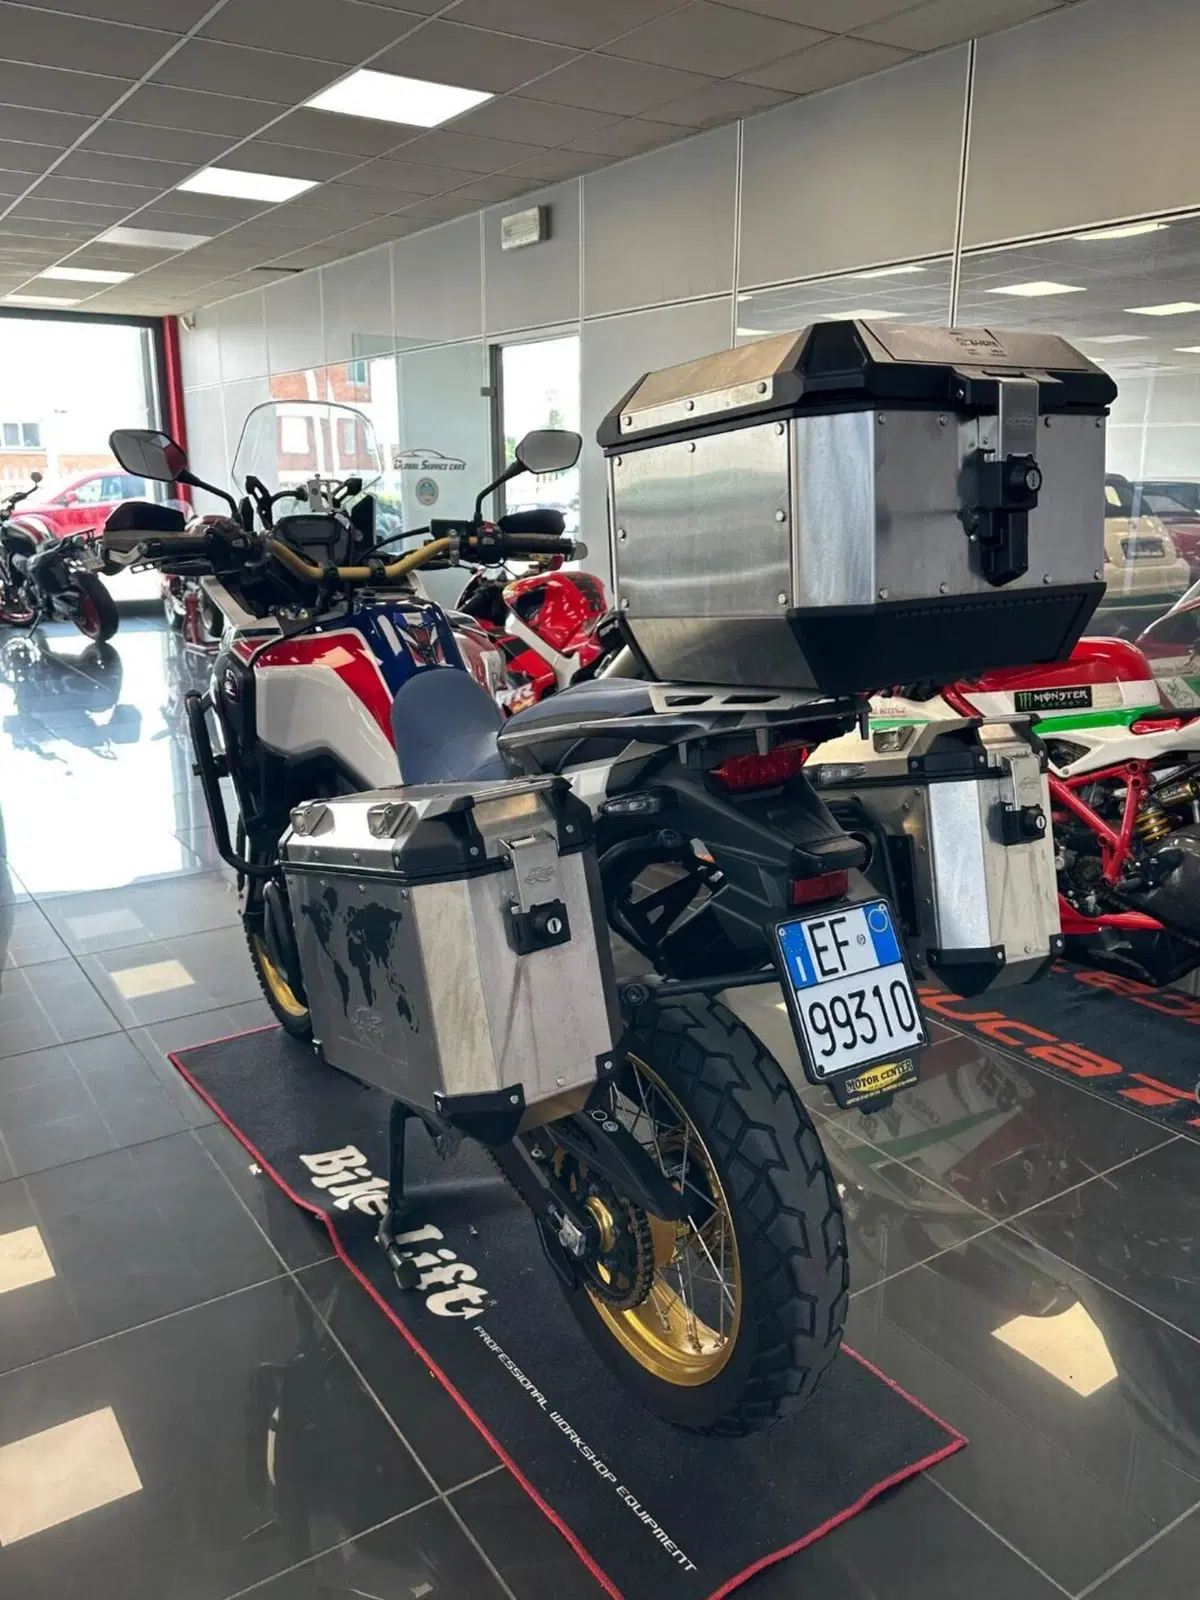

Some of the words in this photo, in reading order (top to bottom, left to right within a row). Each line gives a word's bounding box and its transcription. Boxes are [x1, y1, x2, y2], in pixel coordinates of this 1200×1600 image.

[1033, 689, 1088, 702] MONSTER
[807, 917, 849, 977] EF
[808, 980, 916, 1057] 99310
[846, 1075, 880, 1093] MOTOR
[881, 1059, 913, 1080] CENTER
[299, 1144, 390, 1215] Bike
[374, 1223, 489, 1320] Lift
[473, 1325, 549, 1411] PROFESSIONAL
[549, 1411, 617, 1483] WORKSHOP
[615, 1485, 698, 1572] EQUIPMENT
